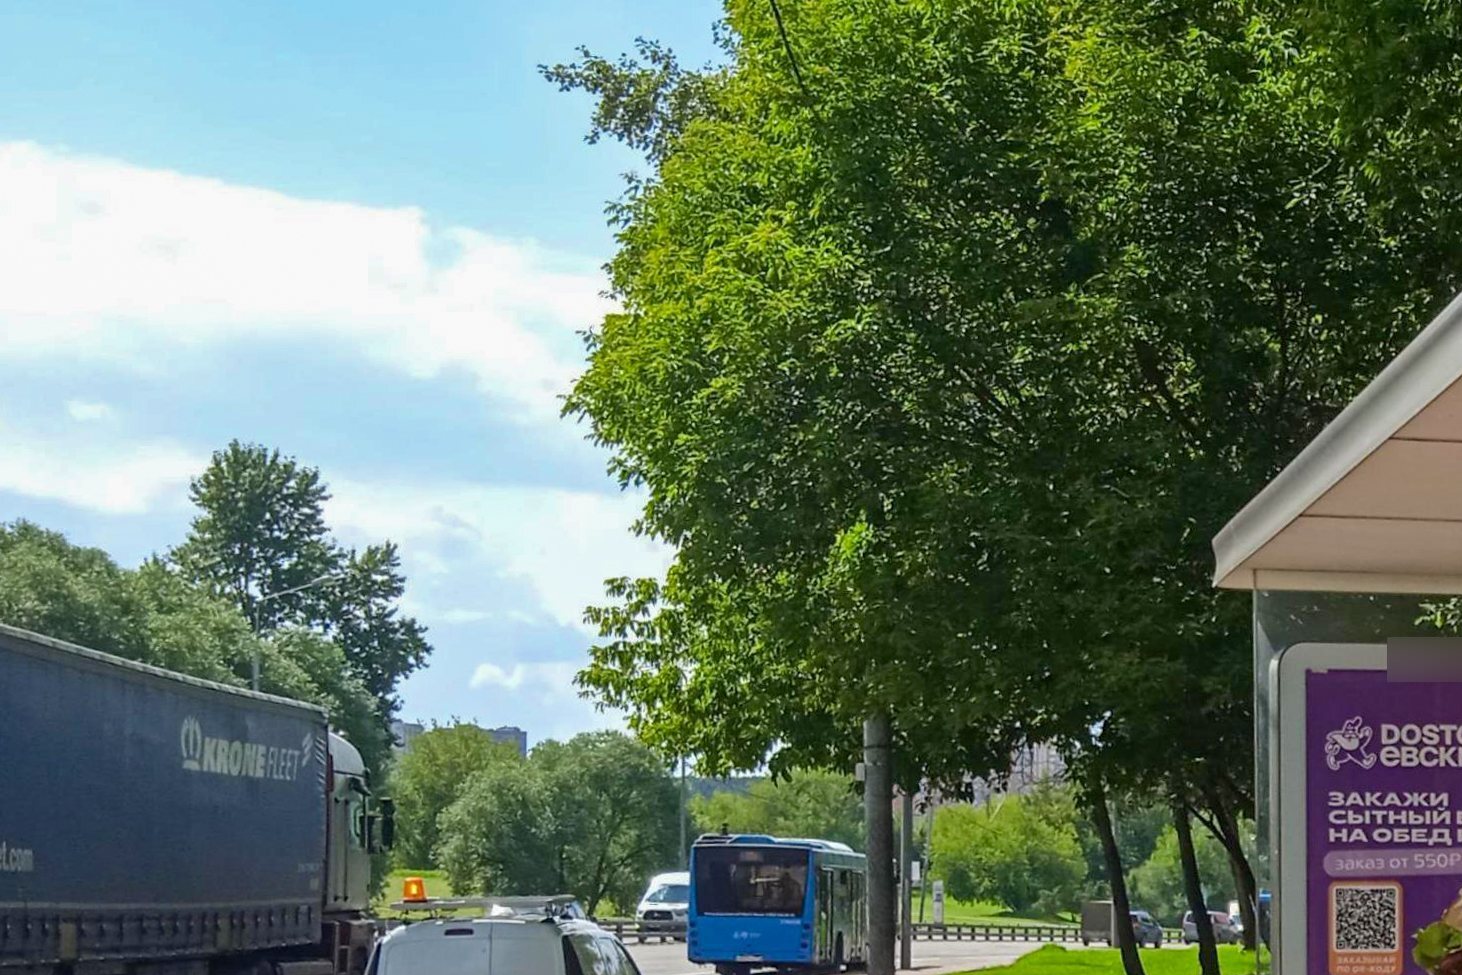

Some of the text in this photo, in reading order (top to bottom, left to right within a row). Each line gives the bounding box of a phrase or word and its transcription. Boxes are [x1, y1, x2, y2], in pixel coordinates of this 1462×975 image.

[203, 736, 301, 781] KRONE FLEET
[1327, 791, 1450, 807] ЗАКАЖИ
[1328, 807, 1451, 825] СЫТНЫЙ
[1328, 828, 1368, 843] НА
[1372, 828, 1453, 846] ОБЕД
[1335, 858, 1385, 871] заказ
[1389, 858, 1409, 869] от
